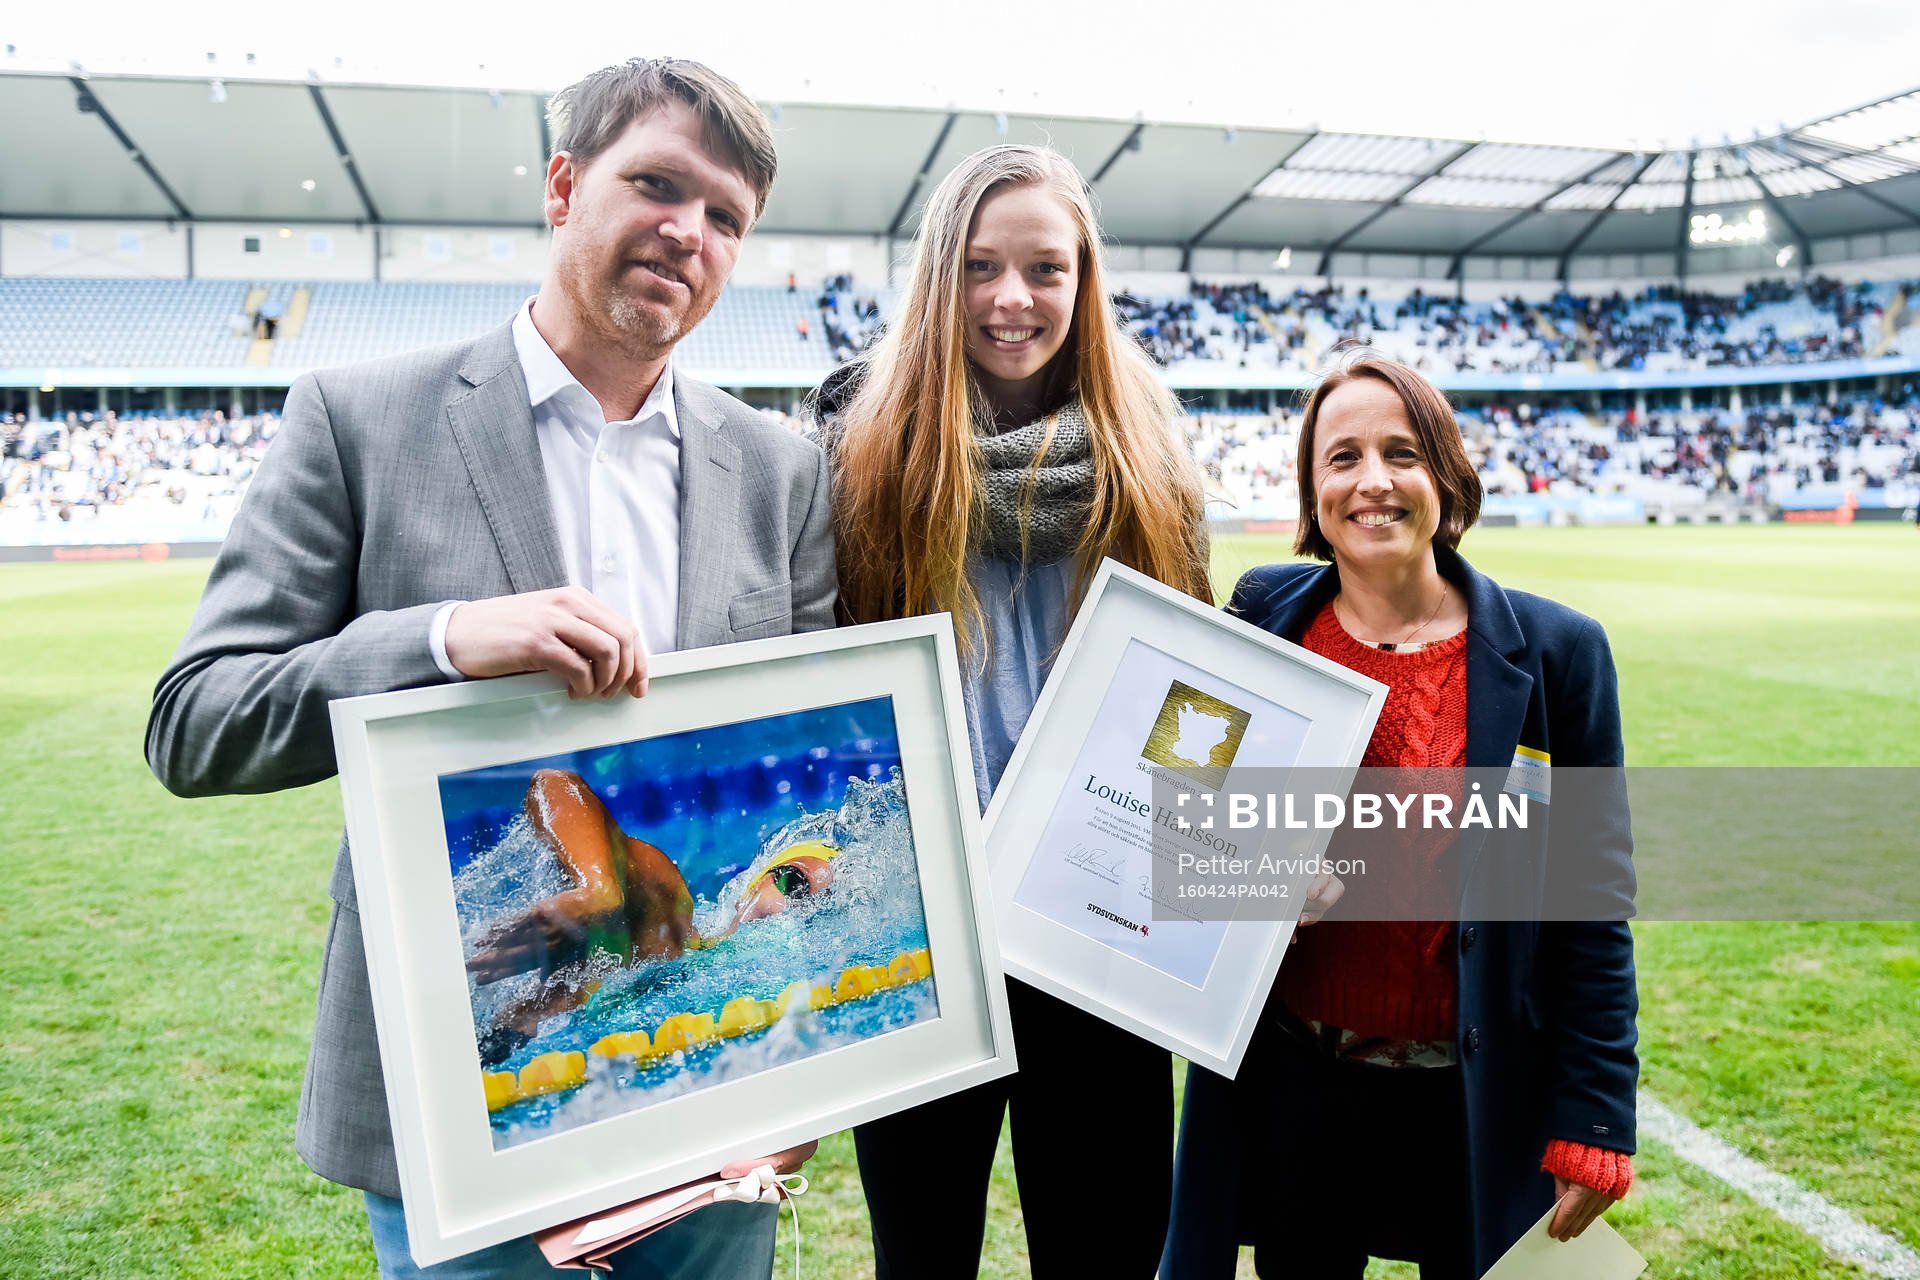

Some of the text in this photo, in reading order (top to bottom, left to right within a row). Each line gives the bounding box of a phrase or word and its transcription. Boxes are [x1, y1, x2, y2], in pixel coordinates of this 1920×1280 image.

[1085, 774, 1151, 817] Louise
[1153, 806, 1239, 859] Hansson
[1086, 903, 1139, 931] SYDSVENSKAN
